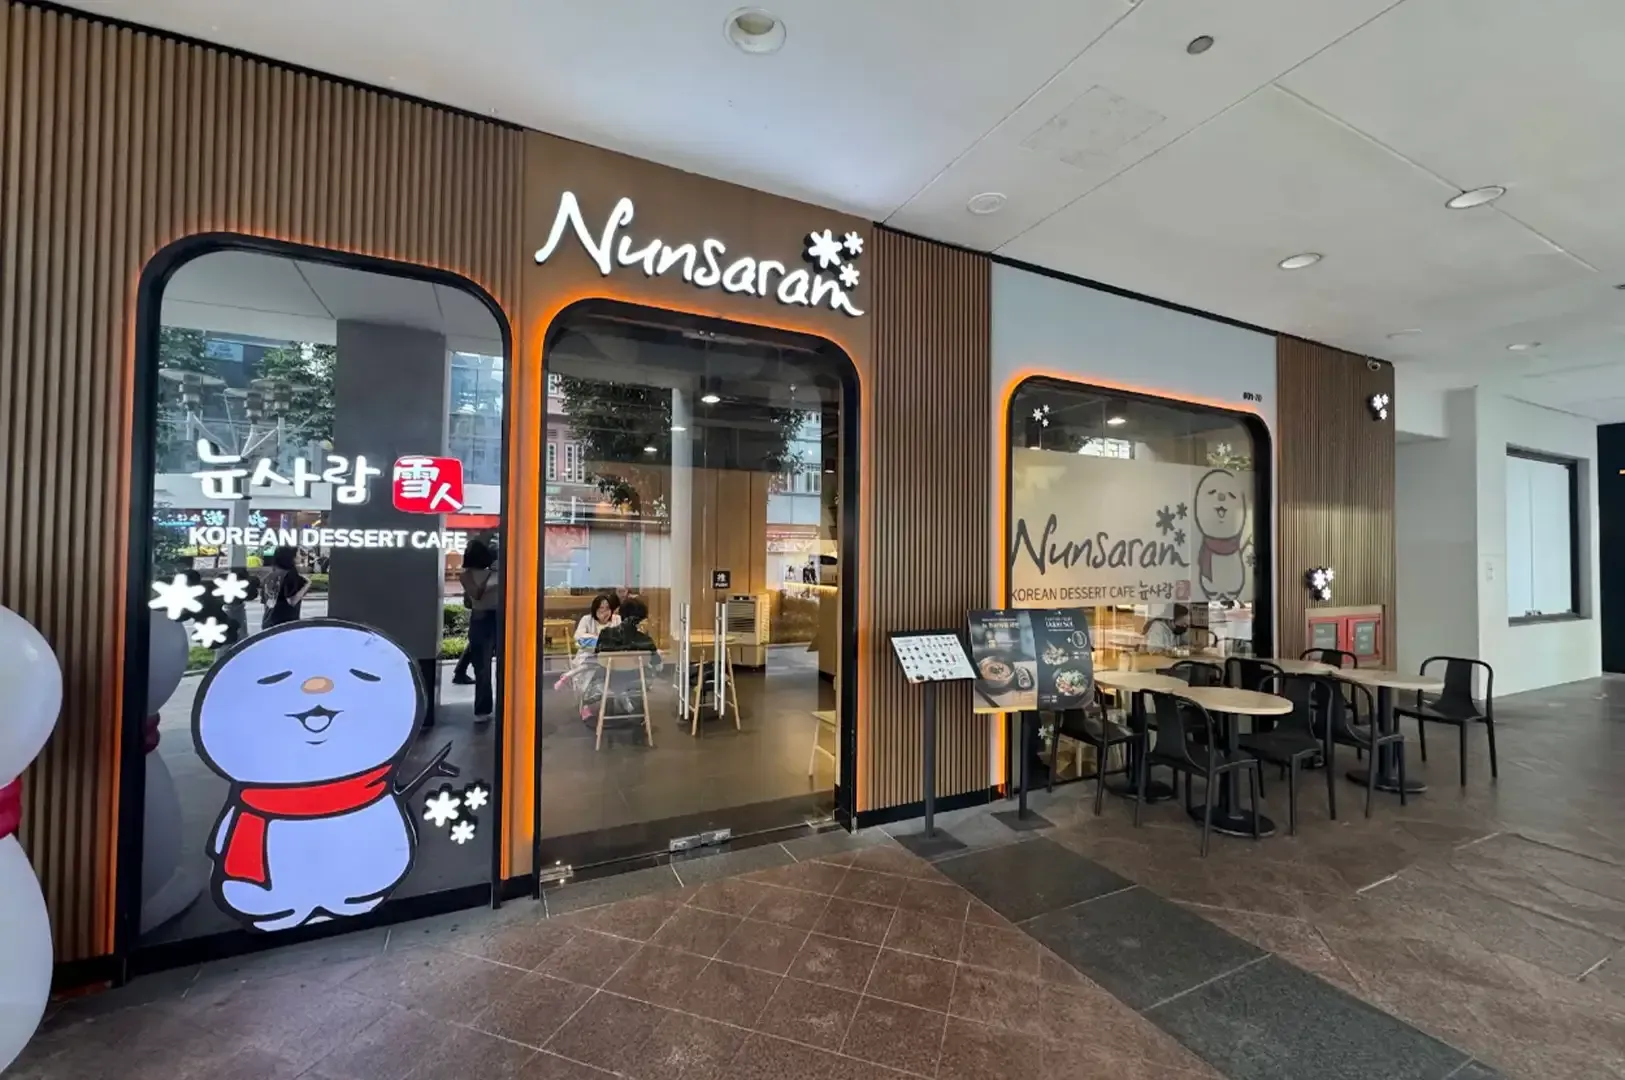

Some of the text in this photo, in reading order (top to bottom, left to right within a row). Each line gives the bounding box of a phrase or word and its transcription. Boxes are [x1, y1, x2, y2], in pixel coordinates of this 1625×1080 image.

[533, 190, 865, 316] Nunsaram
[394, 457, 463, 511] 雪人
[189, 526, 468, 550] KOREAN DESSERT CAFE
[1012, 514, 1190, 575] Nunsaram
[1060, 586, 1107, 601] DESSERT
[1109, 584, 1136, 599] CAFE
